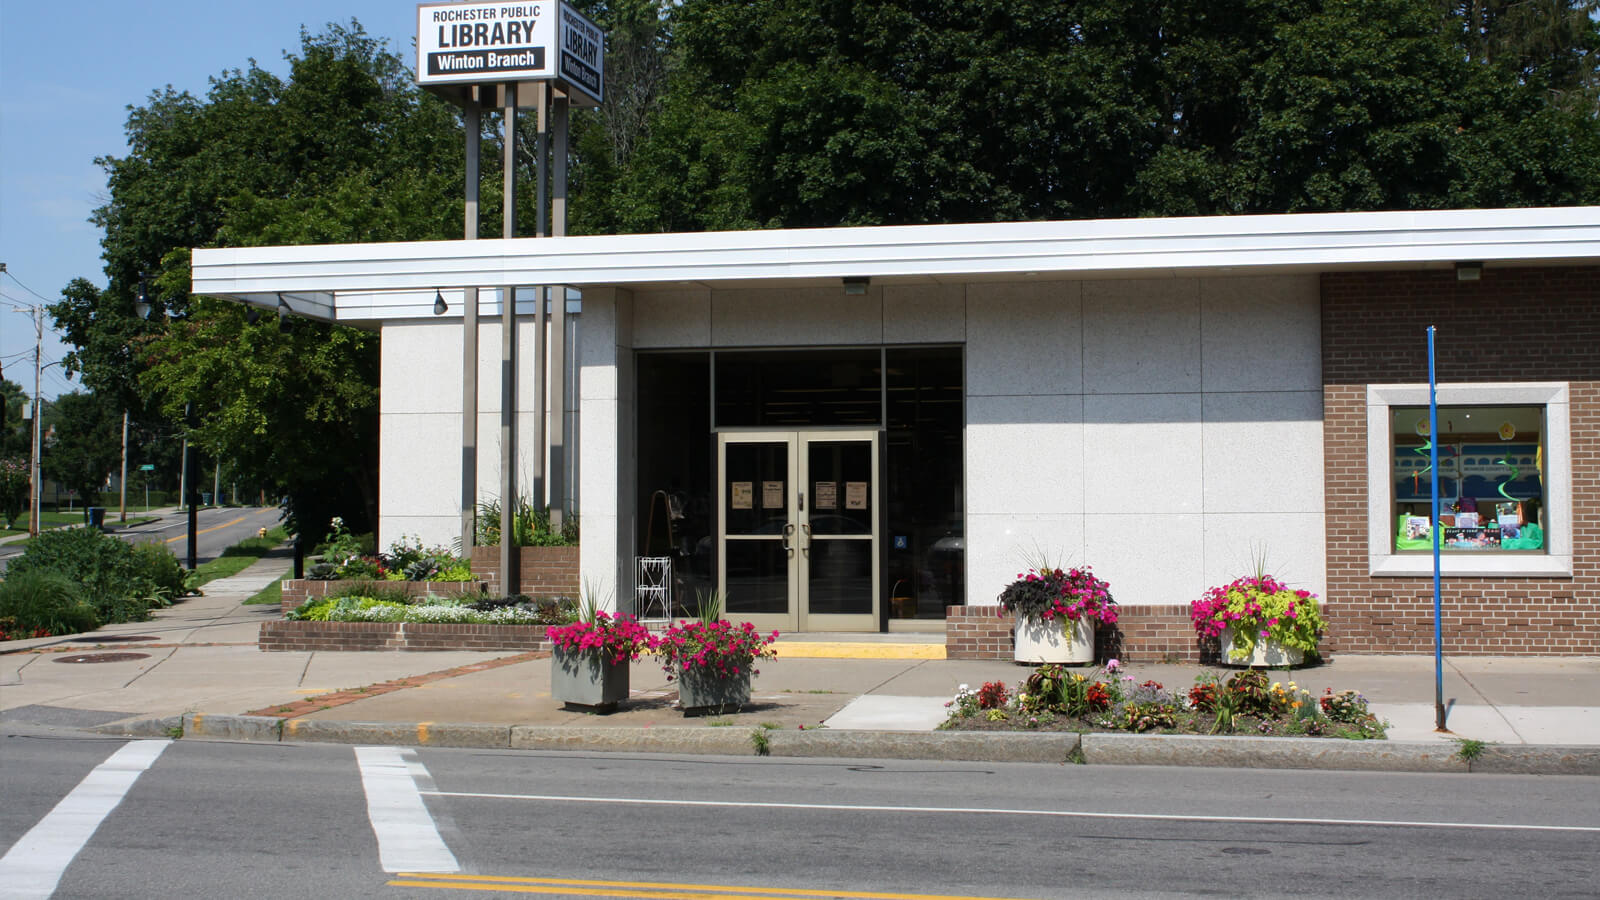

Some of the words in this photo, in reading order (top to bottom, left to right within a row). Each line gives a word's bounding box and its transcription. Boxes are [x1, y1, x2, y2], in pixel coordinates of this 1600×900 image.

[433, 8, 497, 22] ROCHESTER
[501, 5, 540, 18] PUBLIC
[438, 20, 536, 48] LIBRARY
[565, 24, 598, 68] LIBRARY
[437, 53, 484, 70] Winton
[488, 50, 535, 68] Branch
[564, 54, 581, 79] Winton
[581, 65, 598, 90] Branch
